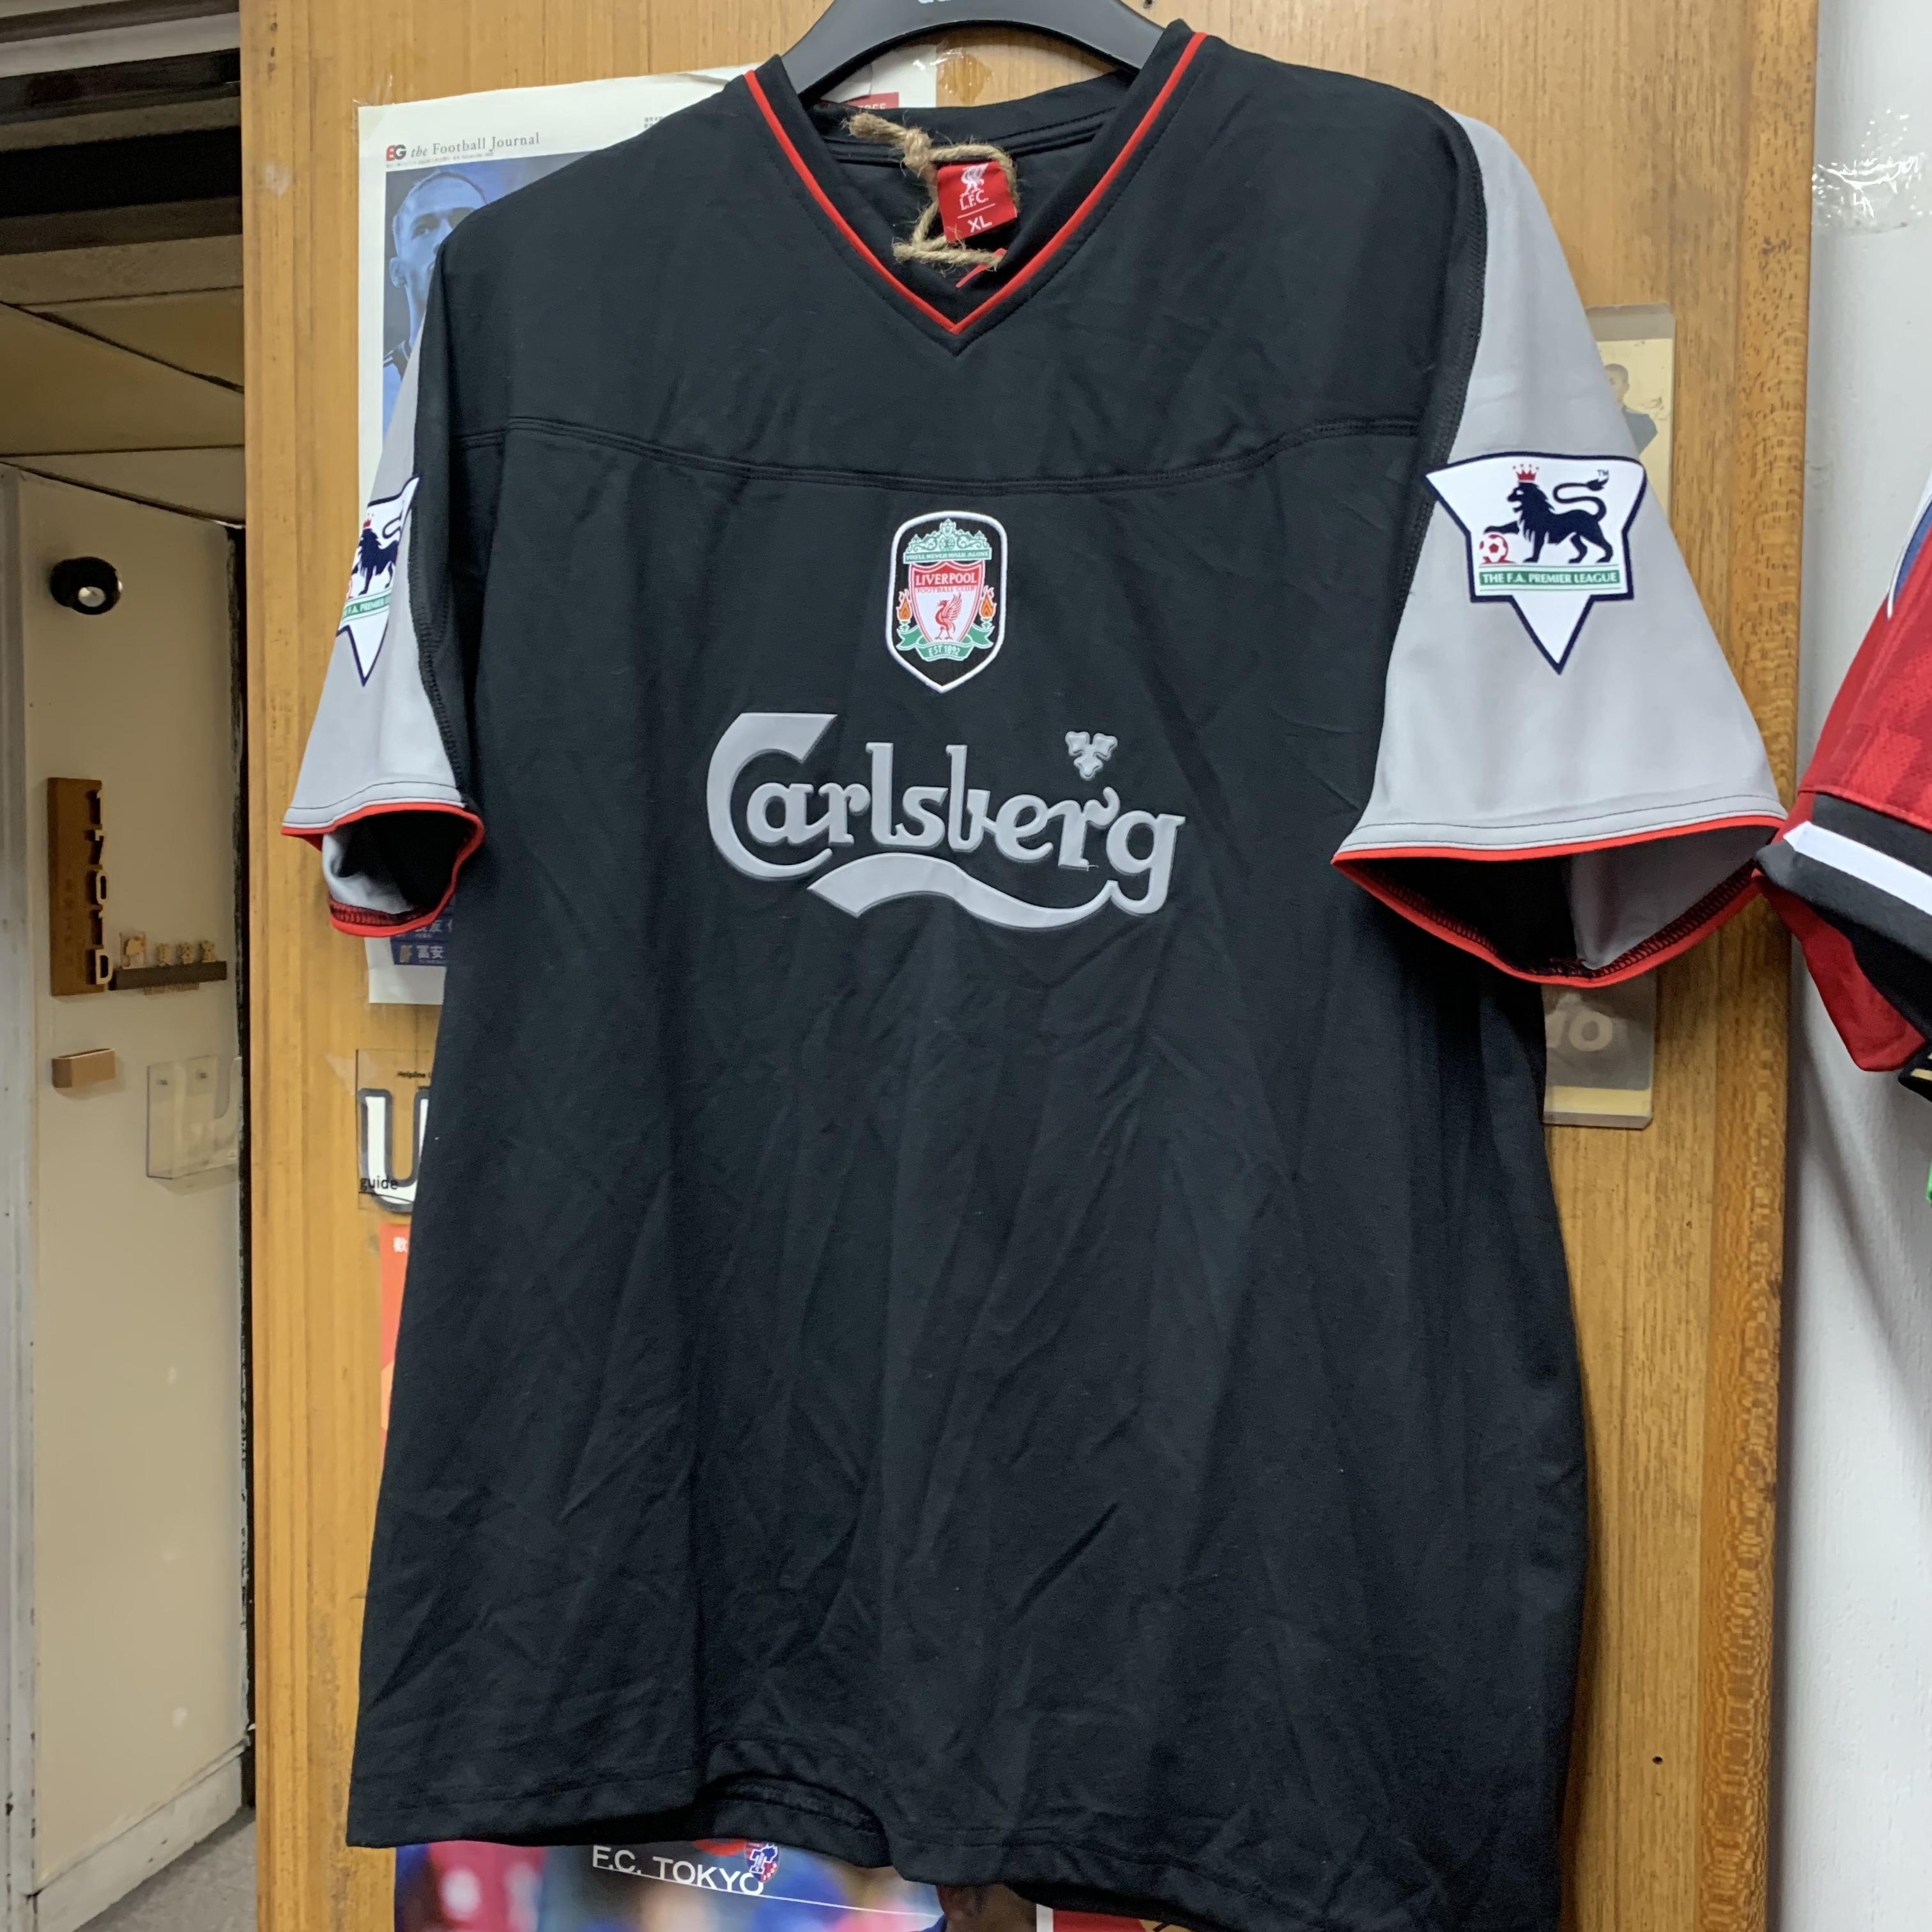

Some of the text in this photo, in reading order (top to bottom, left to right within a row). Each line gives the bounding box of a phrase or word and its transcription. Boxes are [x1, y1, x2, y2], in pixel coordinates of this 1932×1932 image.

[411, 145, 427, 158] the
[433, 137, 486, 155] Football
[489, 132, 540, 152] Journal
[967, 215, 993, 233] XL
[1597, 470, 1609, 478] TM
[916, 572, 977, 586] LIVERPOOL
[1482, 572, 1618, 584] THE F.A. PREMIER LEAGUE
[944, 645, 961, 656] 1892
[707, 712, 1186, 928] Carlsberg
[360, 1176, 399, 1191] guide
[592, 1844, 764, 1896] F.C. TOKYO
